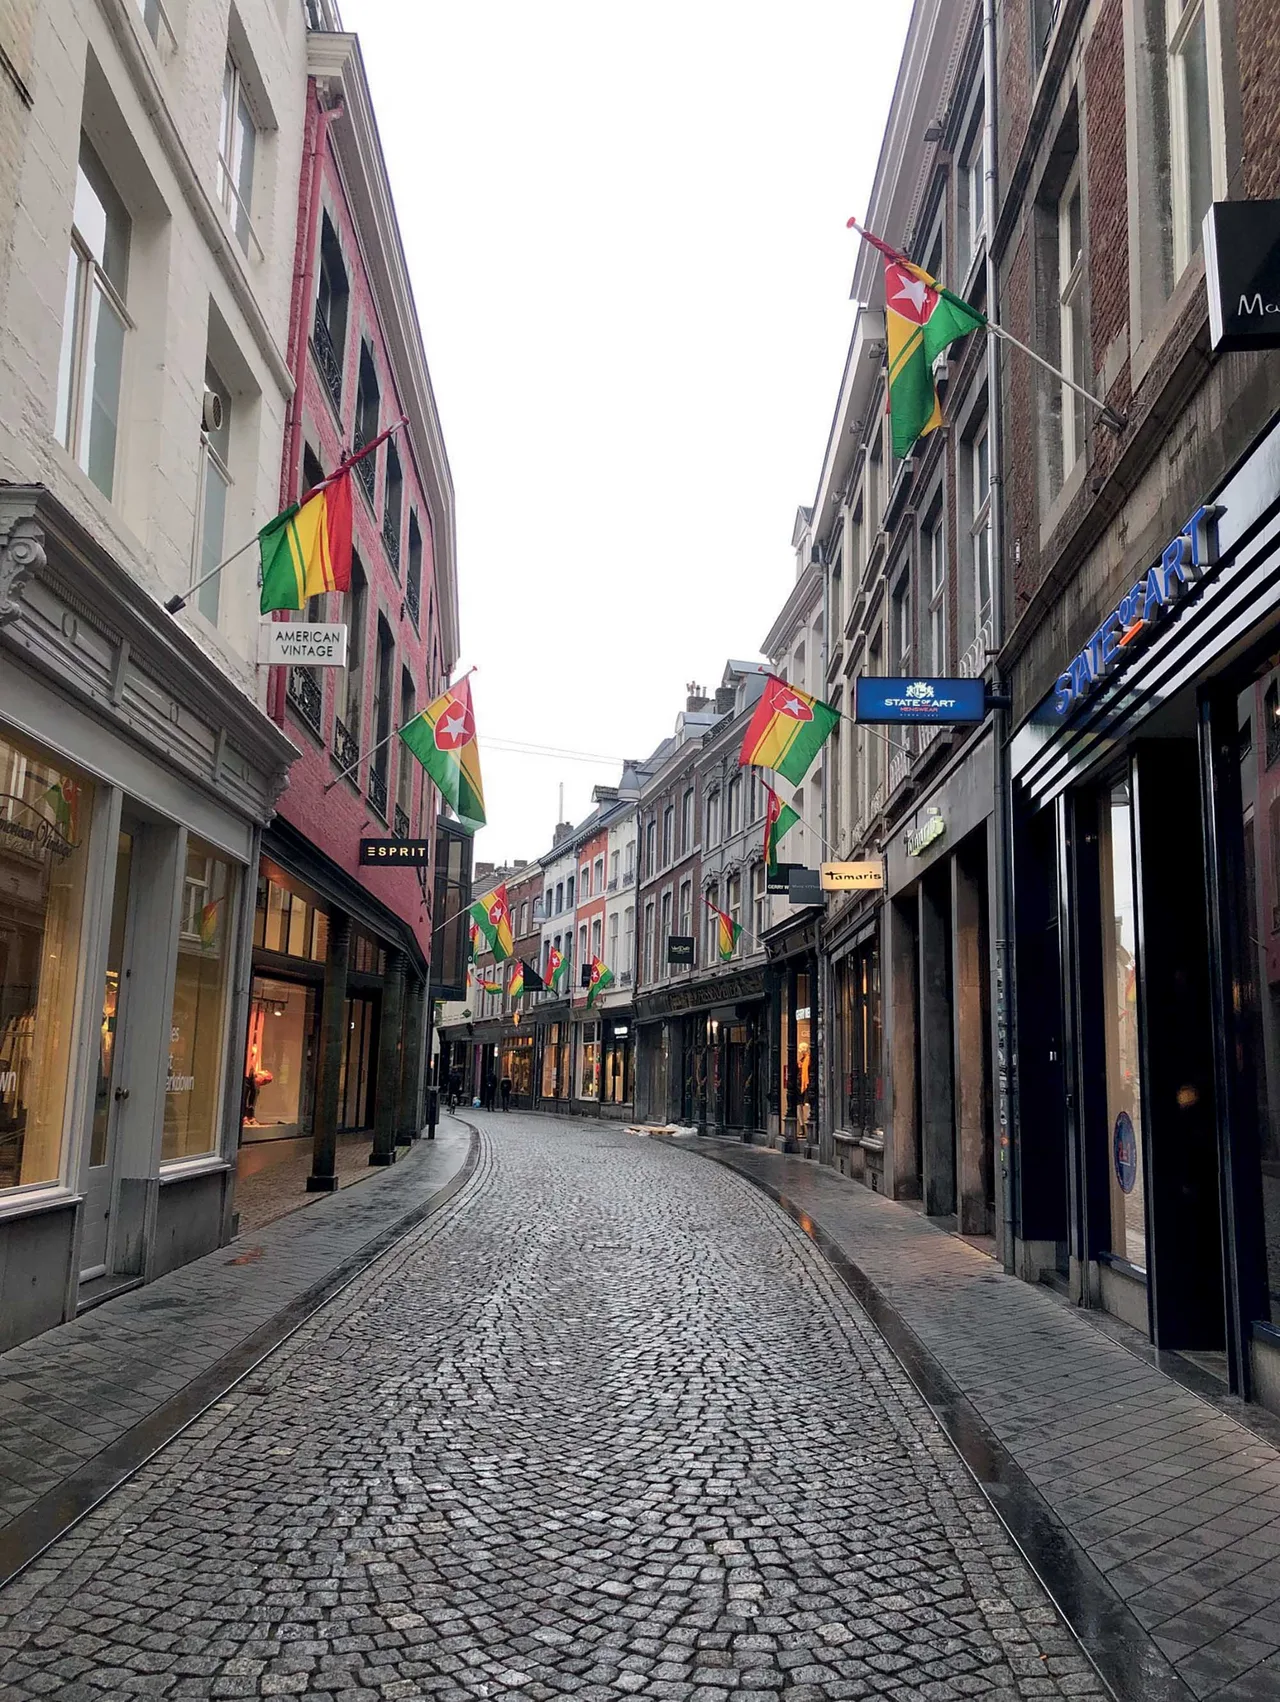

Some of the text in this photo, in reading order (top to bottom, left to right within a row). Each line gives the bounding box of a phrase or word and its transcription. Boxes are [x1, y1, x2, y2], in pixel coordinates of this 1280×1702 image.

[1055, 611, 1122, 715] STATE
[1143, 505, 1210, 620] ART
[276, 631, 340, 643] AMERICAN
[281, 645, 333, 657] VINTAGE
[884, 698, 920, 707] STATE
[931, 699, 955, 708] ART
[367, 846, 426, 857] ESPRIT
